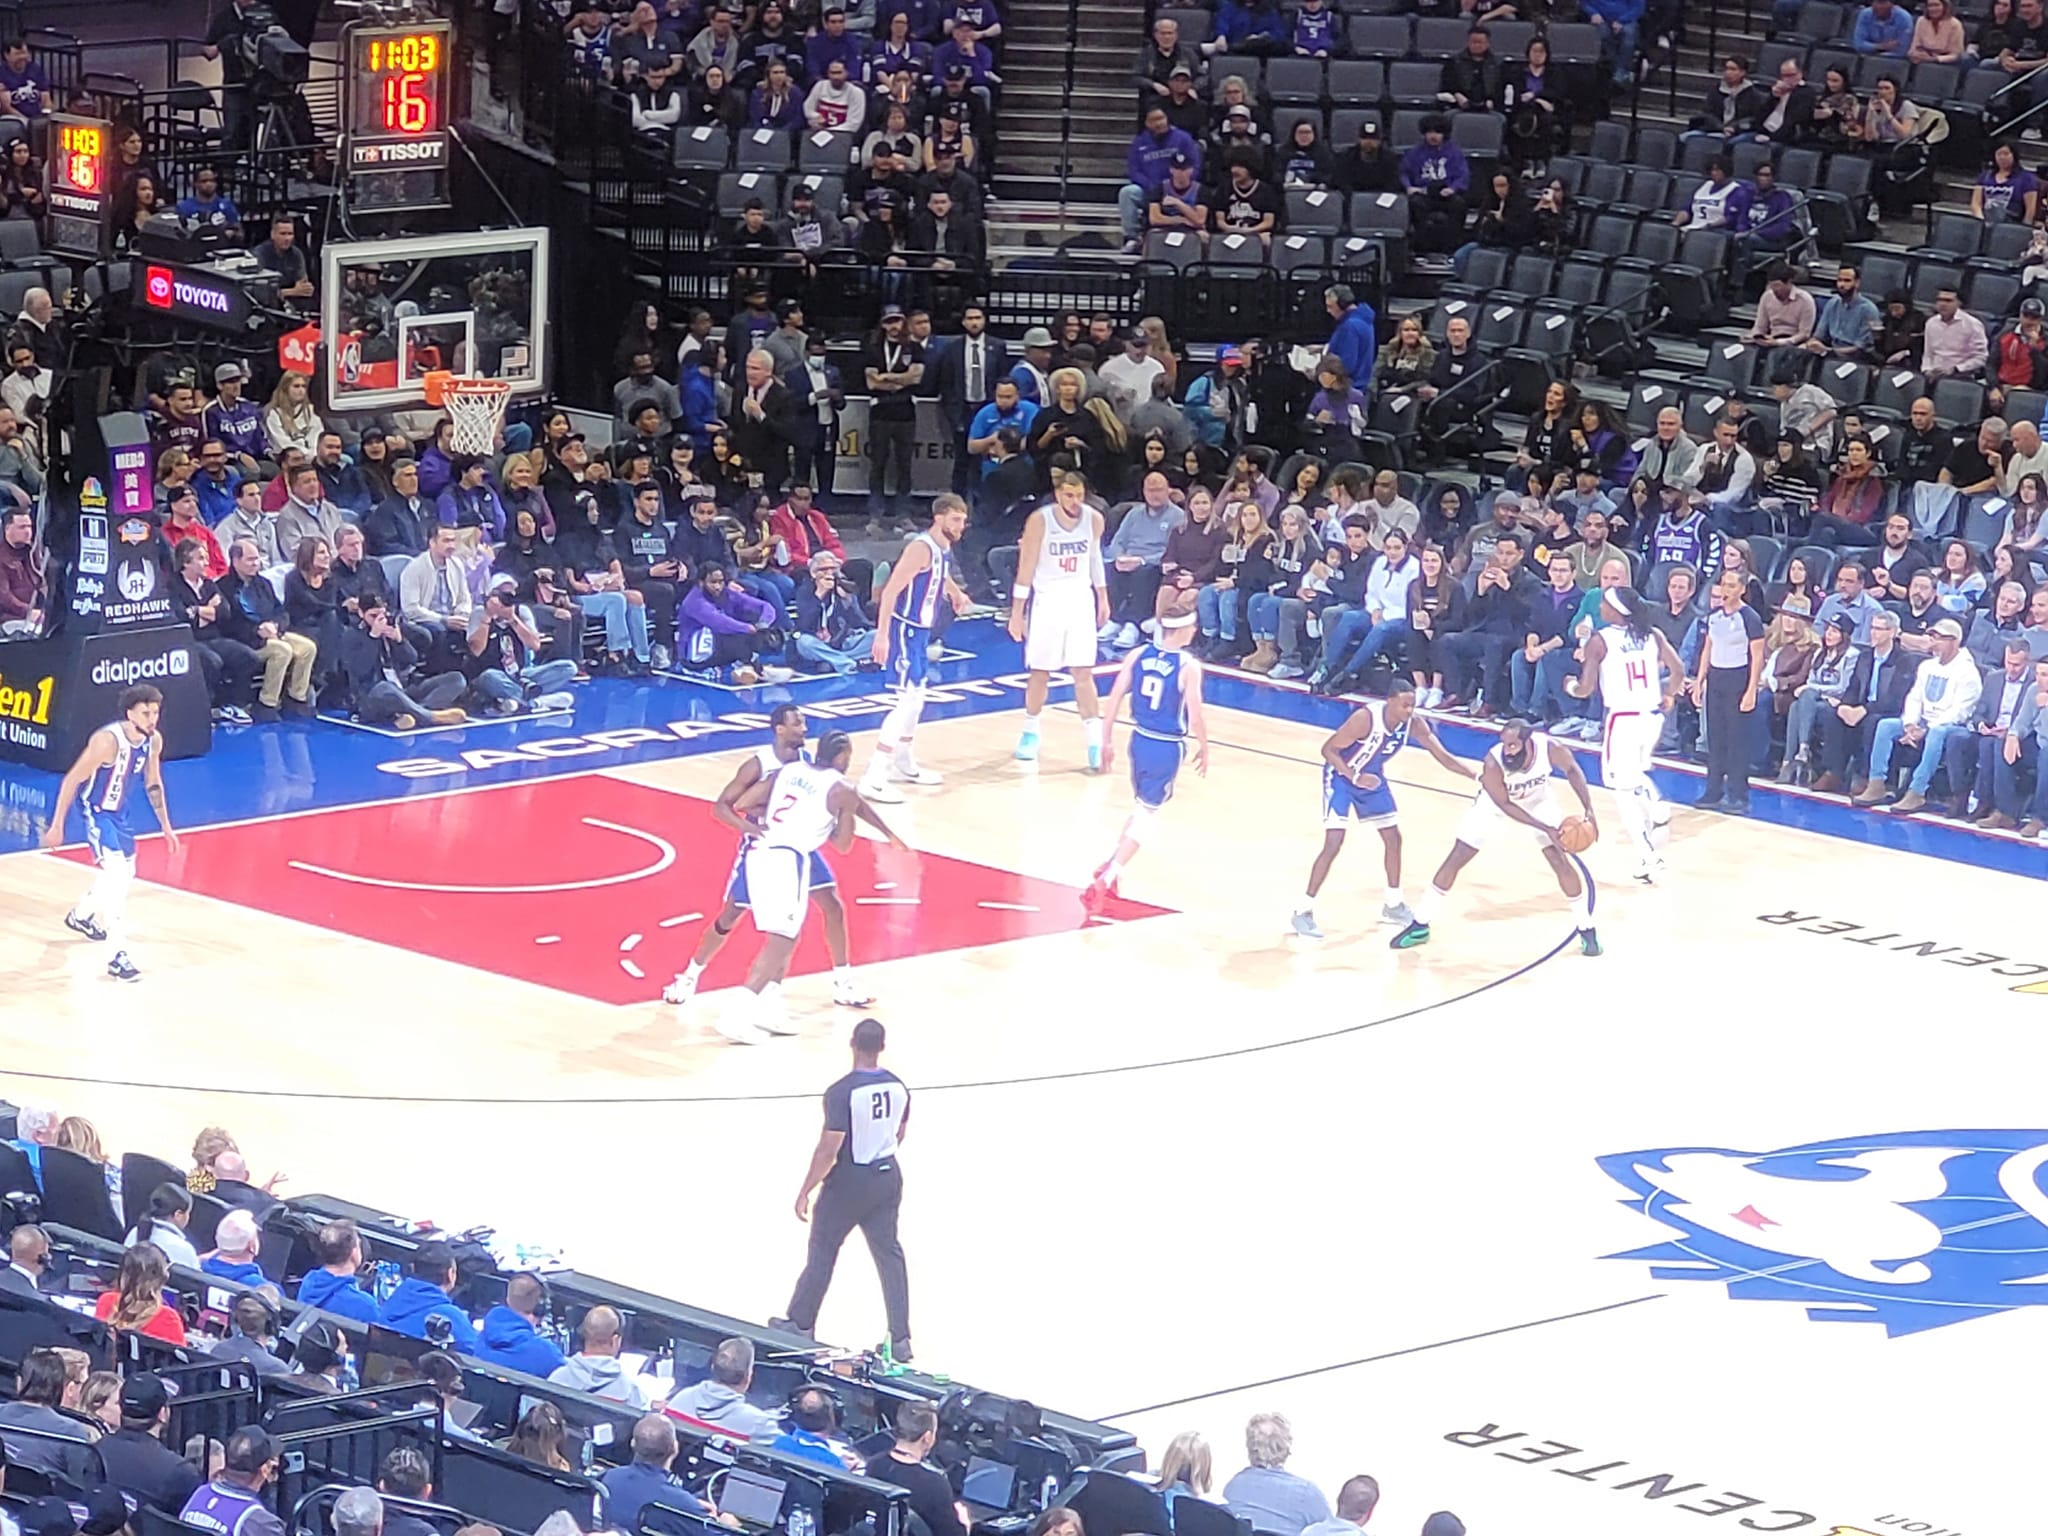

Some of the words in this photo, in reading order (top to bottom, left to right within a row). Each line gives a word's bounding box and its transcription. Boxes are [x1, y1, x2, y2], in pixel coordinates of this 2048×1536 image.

[370, 36, 436, 71] 11:03
[385, 74, 426, 131] 16
[381, 141, 443, 161] TISSOT
[70, 154, 93, 187] 16
[173, 282, 229, 312] TOYOTA
[1049, 539, 1088, 556] CLIPPERS
[1058, 556, 1077, 573] 40
[104, 599, 171, 618] REDHAWK
[92, 652, 169, 685] dialpad
[1625, 659, 1648, 692] 14
[1140, 675, 1164, 711] 9
[9, 722, 47, 750] Union
[771, 793, 798, 824] 2
[1756, 910, 2048, 976] CENTER
[871, 1089, 890, 1120] 21
[1443, 1423, 1817, 1532] CENTER
